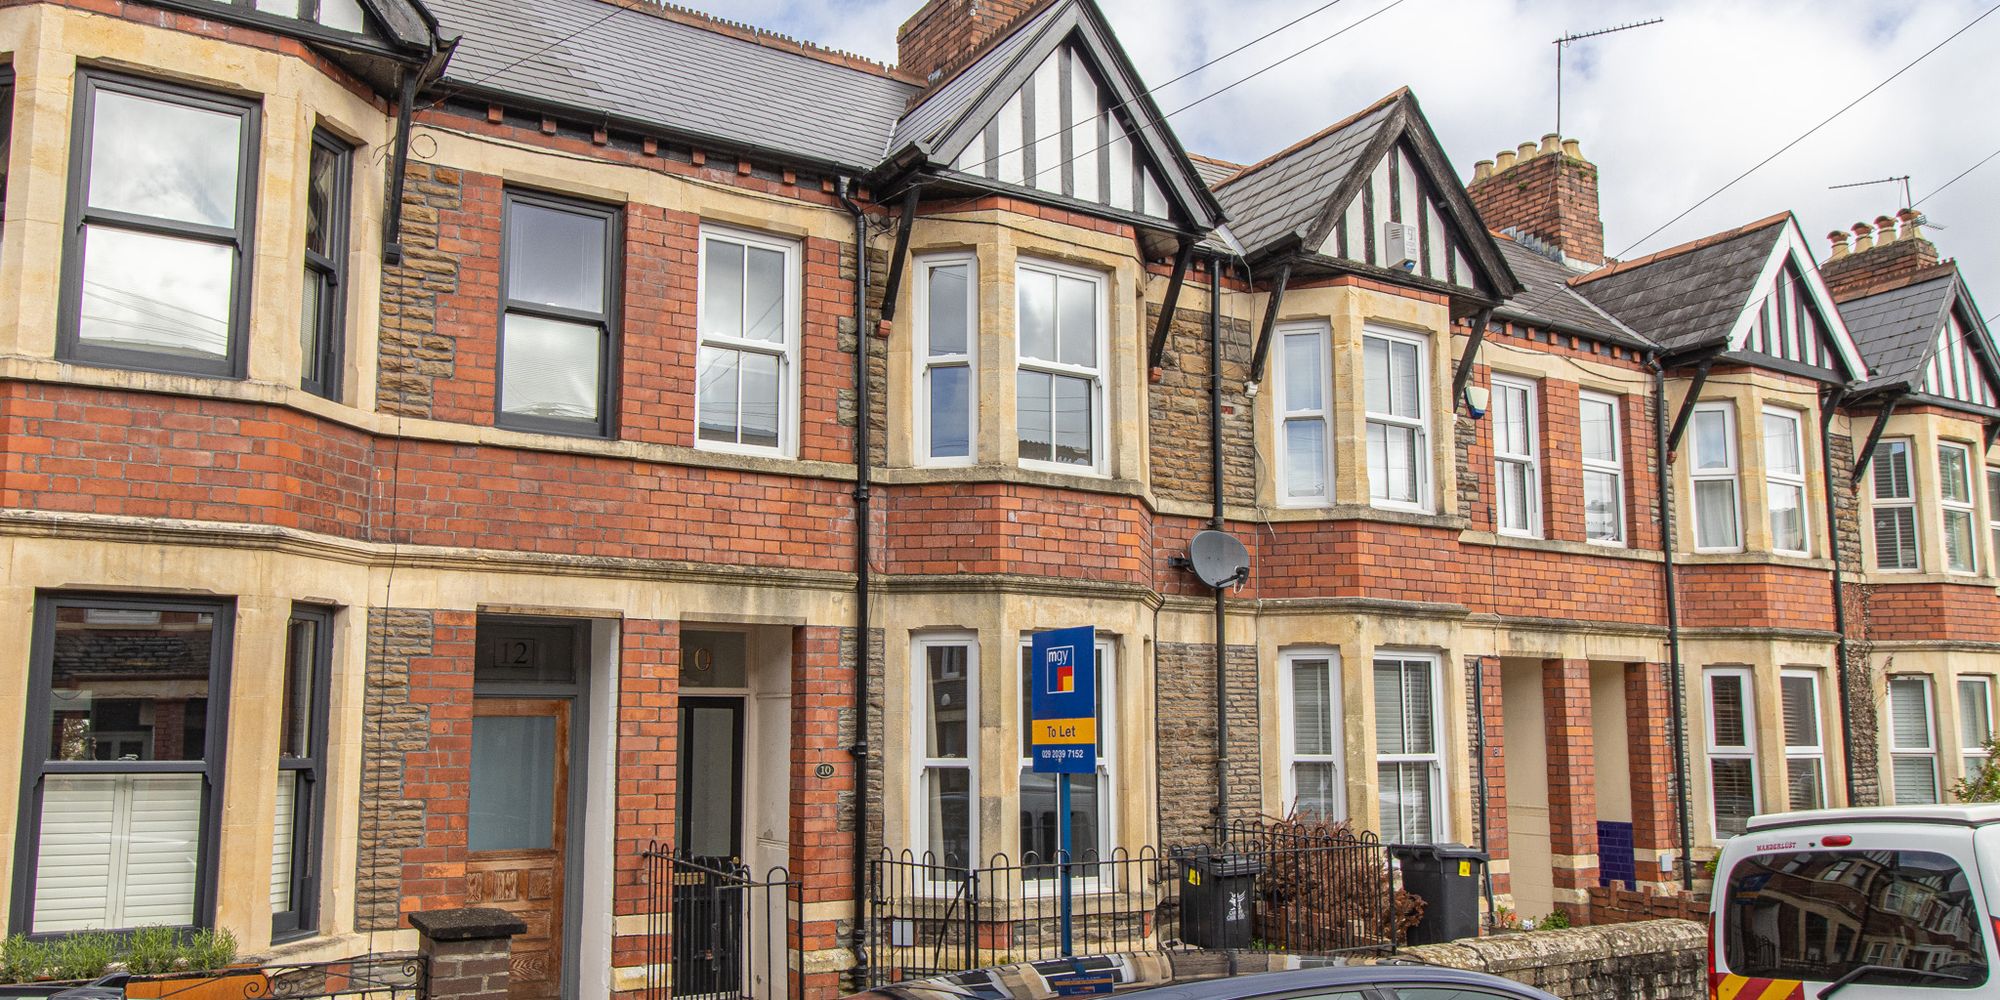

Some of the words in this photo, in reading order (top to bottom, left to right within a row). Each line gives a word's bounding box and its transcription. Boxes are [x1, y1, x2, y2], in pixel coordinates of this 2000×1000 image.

[502, 642, 528, 664] 12
[1048, 650, 1068, 665] mgy
[1047, 726, 1057, 738] To
[1059, 725, 1076, 738] Let
[1042, 750, 1051, 759] 029
[1068, 750, 1083, 759] 7152
[820, 766, 831, 775] 10
[1757, 842, 1797, 852] WANDERLUST
